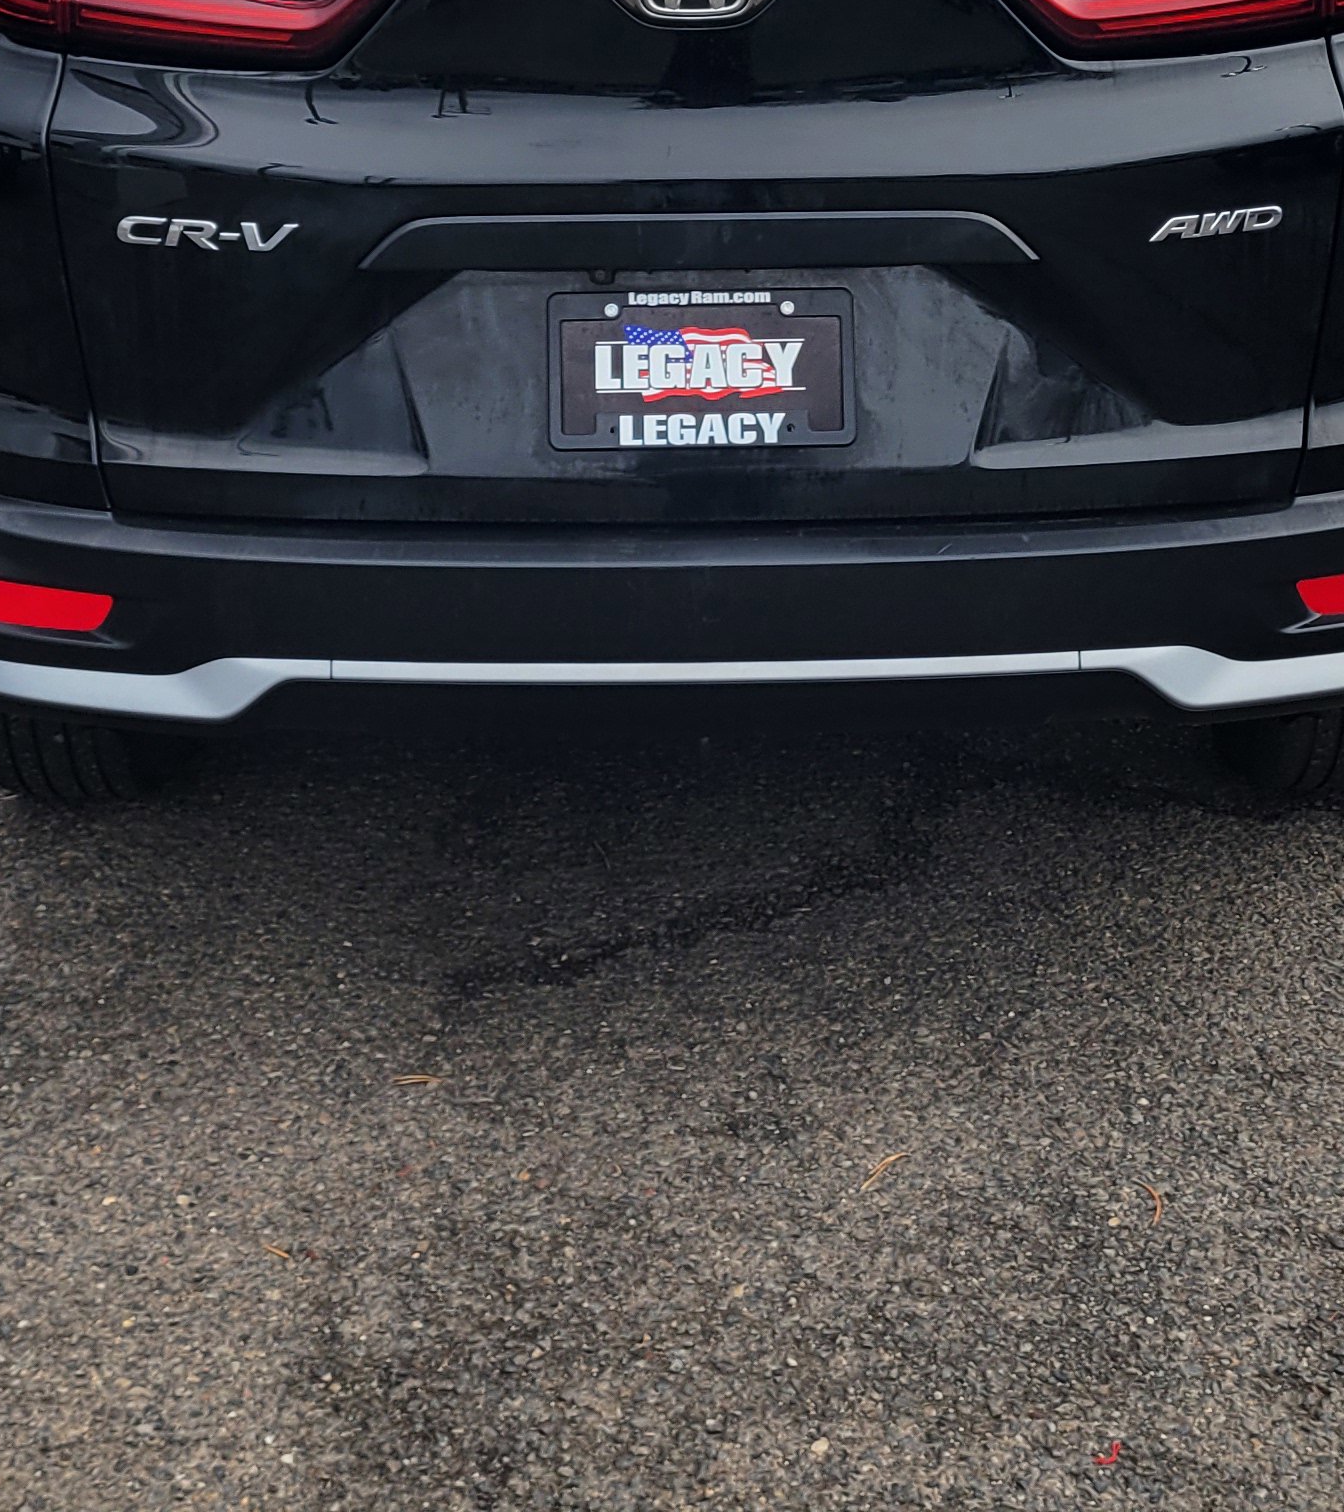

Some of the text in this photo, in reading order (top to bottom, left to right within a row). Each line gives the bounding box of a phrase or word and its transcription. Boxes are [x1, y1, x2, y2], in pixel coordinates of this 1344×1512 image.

[116, 215, 299, 252] CR-V
[1148, 205, 1283, 243] AWD
[594, 342, 803, 390] LEGACY
[619, 412, 786, 446] LEGACY
